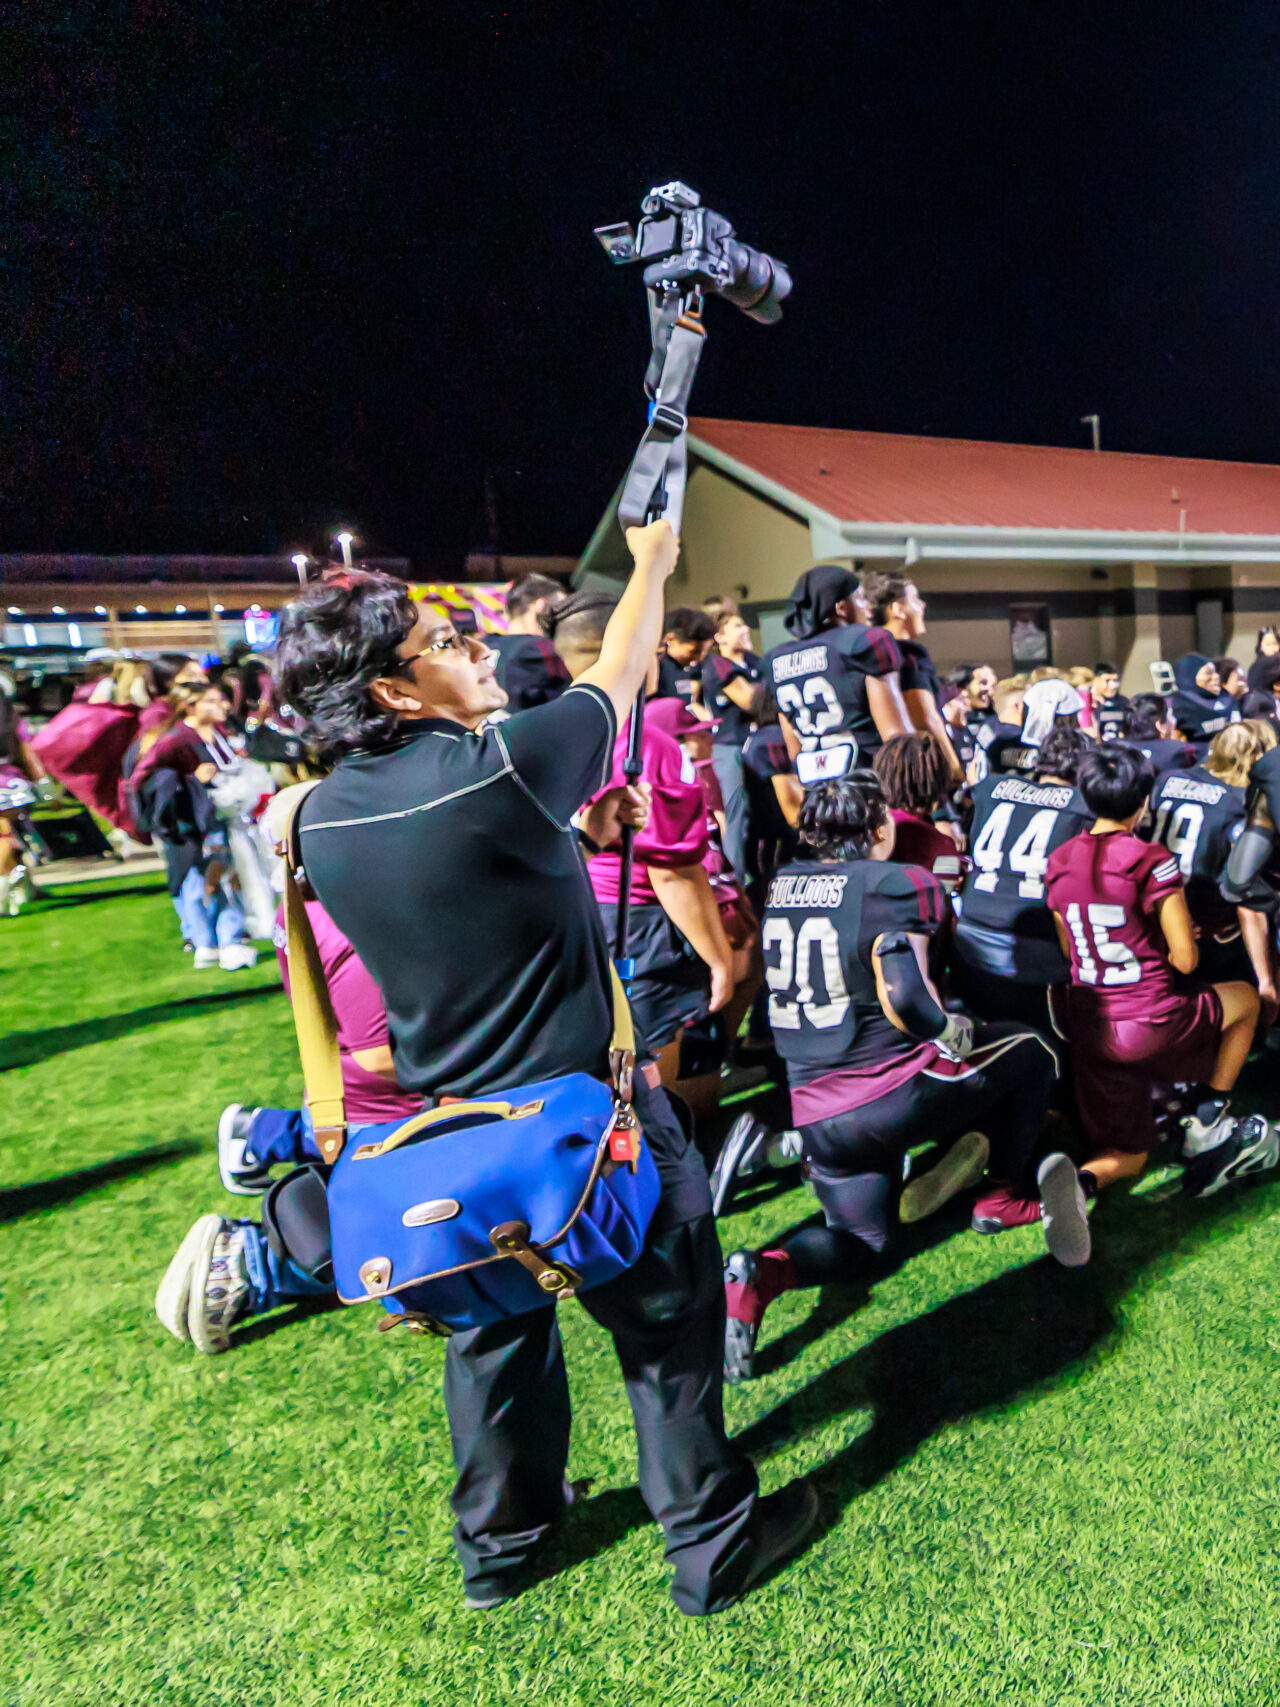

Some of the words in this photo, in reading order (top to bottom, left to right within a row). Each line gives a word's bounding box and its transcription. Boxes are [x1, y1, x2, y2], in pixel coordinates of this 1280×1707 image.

[991, 778, 1074, 809] BULLDOGS
[764, 875, 848, 908] BULLDOGS
[973, 802, 1060, 899] 44
[762, 916, 850, 1030] 20
[1066, 902, 1142, 987] 15
